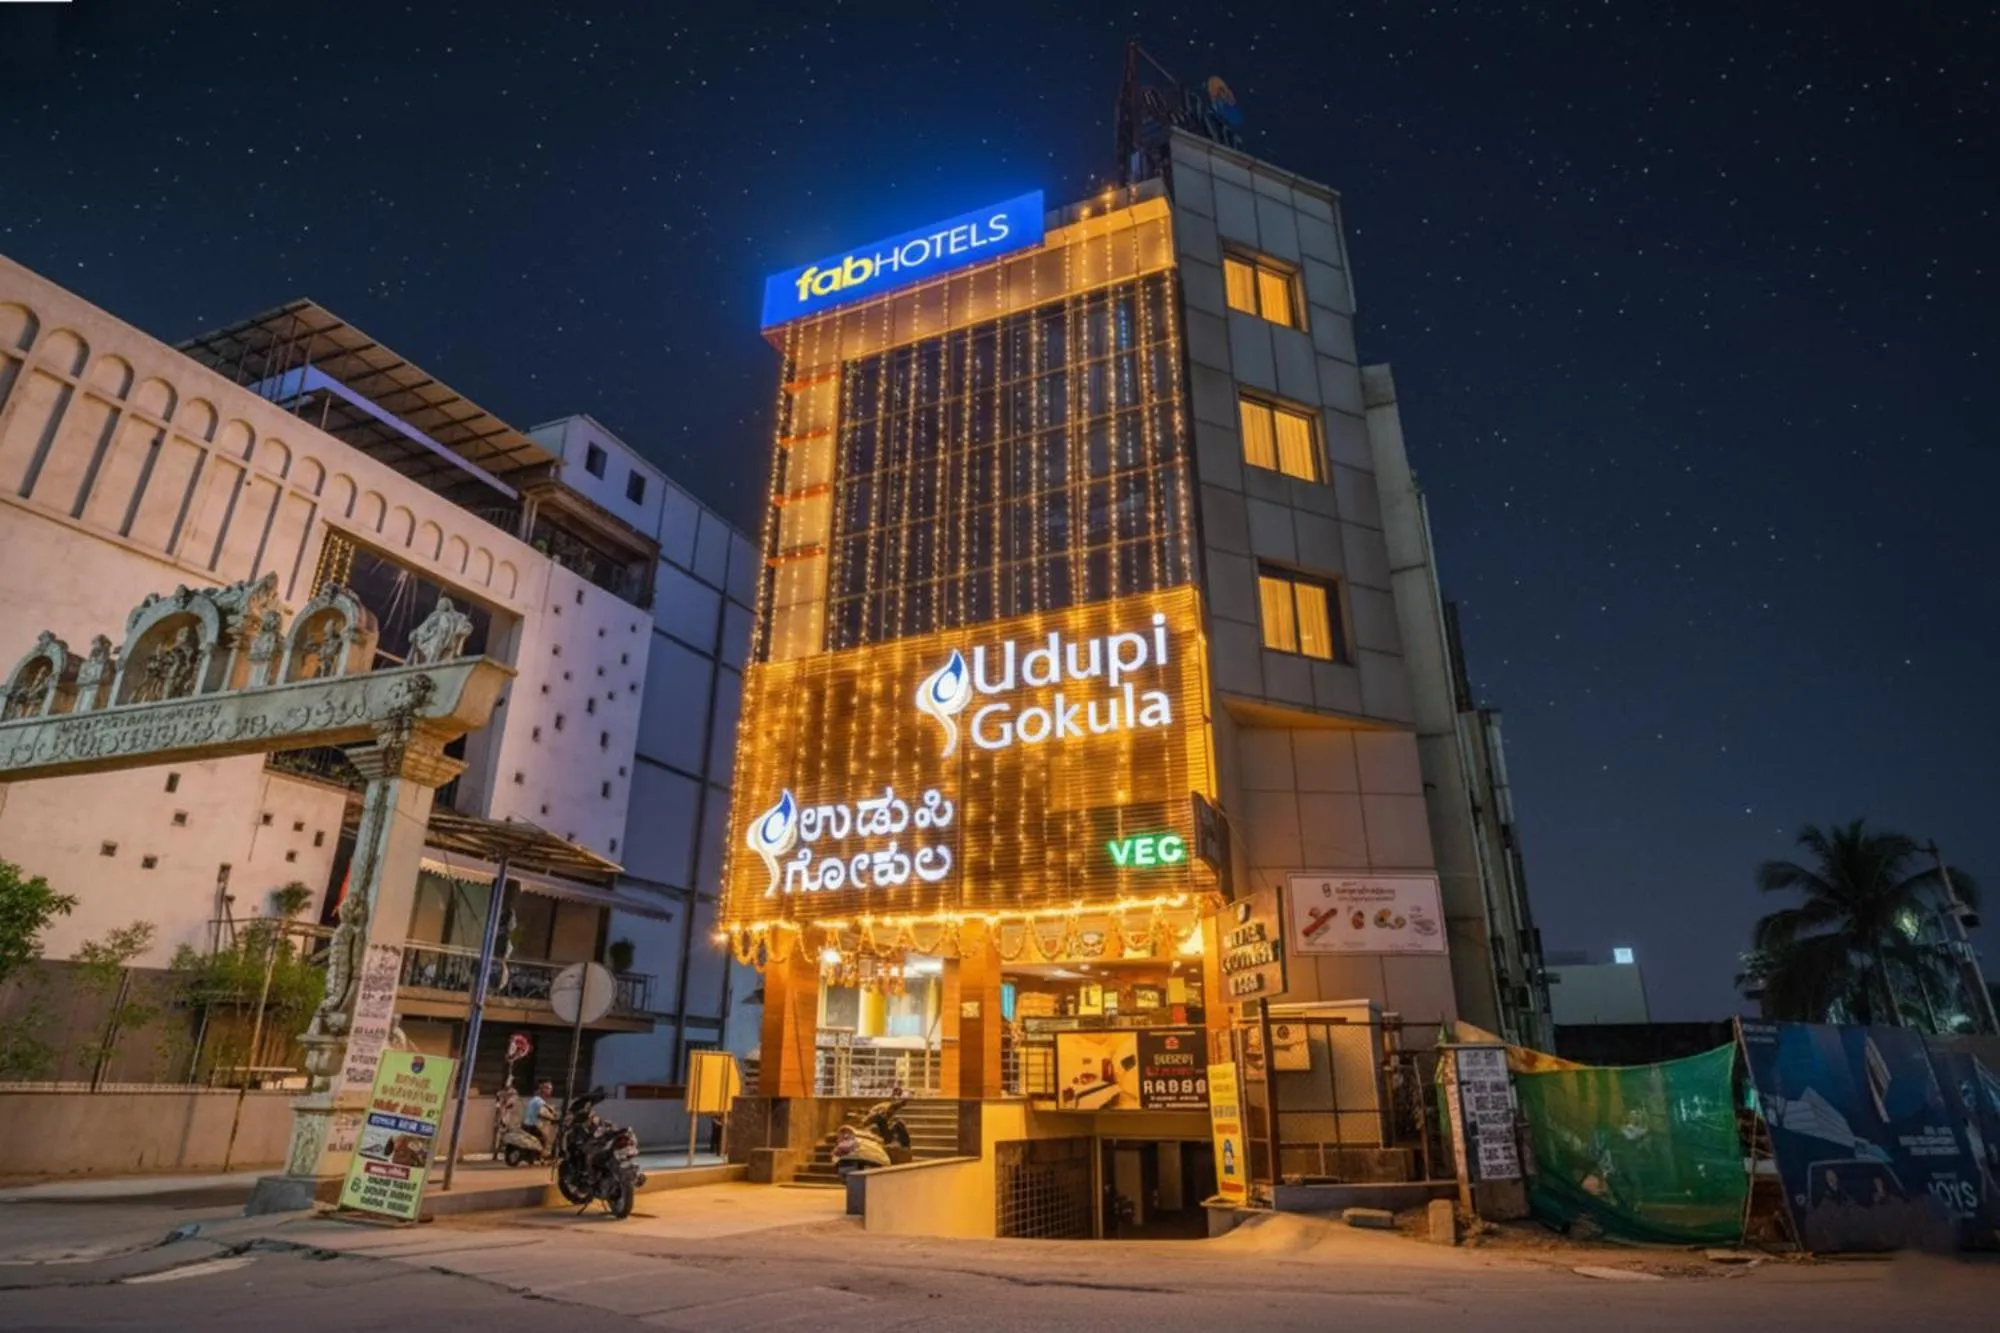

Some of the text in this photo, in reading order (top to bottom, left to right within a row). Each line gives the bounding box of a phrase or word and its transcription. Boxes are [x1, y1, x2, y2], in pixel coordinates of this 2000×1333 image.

[972, 613, 1168, 695] Udupi
[971, 682, 1173, 749] Gokula
[800, 786, 954, 842] ಉಡುಪಿ
[784, 841, 953, 893] ಗೋಕುಲ
[1108, 834, 1184, 866] VEG
